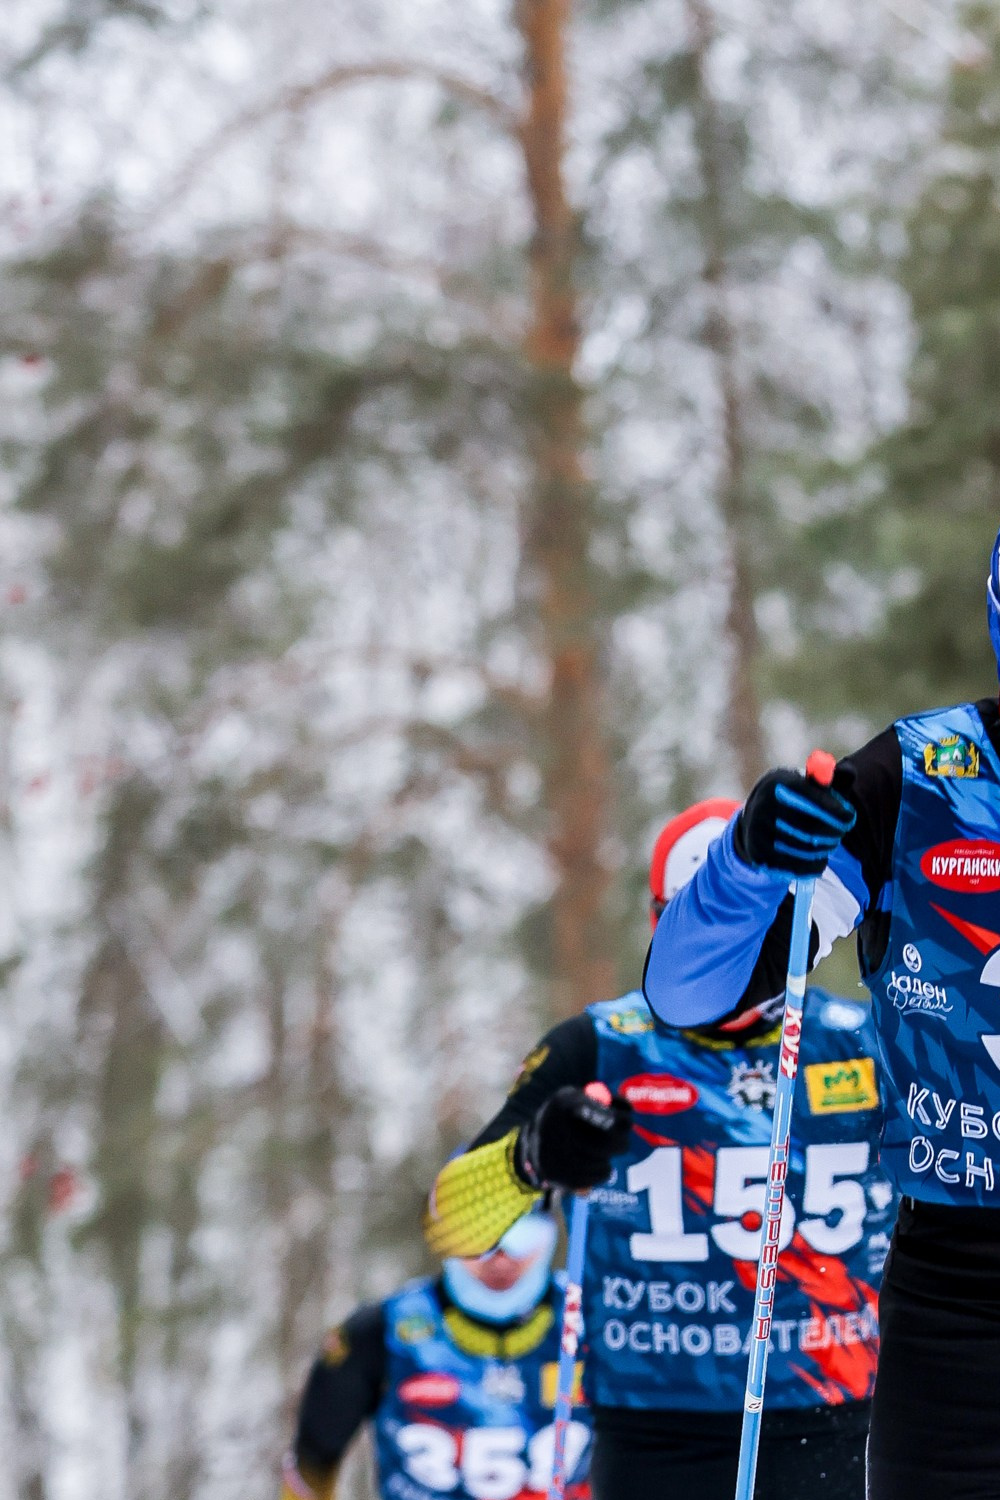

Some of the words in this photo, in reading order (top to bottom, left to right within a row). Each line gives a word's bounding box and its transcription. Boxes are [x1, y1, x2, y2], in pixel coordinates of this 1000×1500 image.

[782, 1004, 802, 1079] KV+
[626, 1141, 870, 1263] 155
[755, 1134, 790, 1340] TEMPESTA
[603, 1276, 737, 1314] КУБОК
